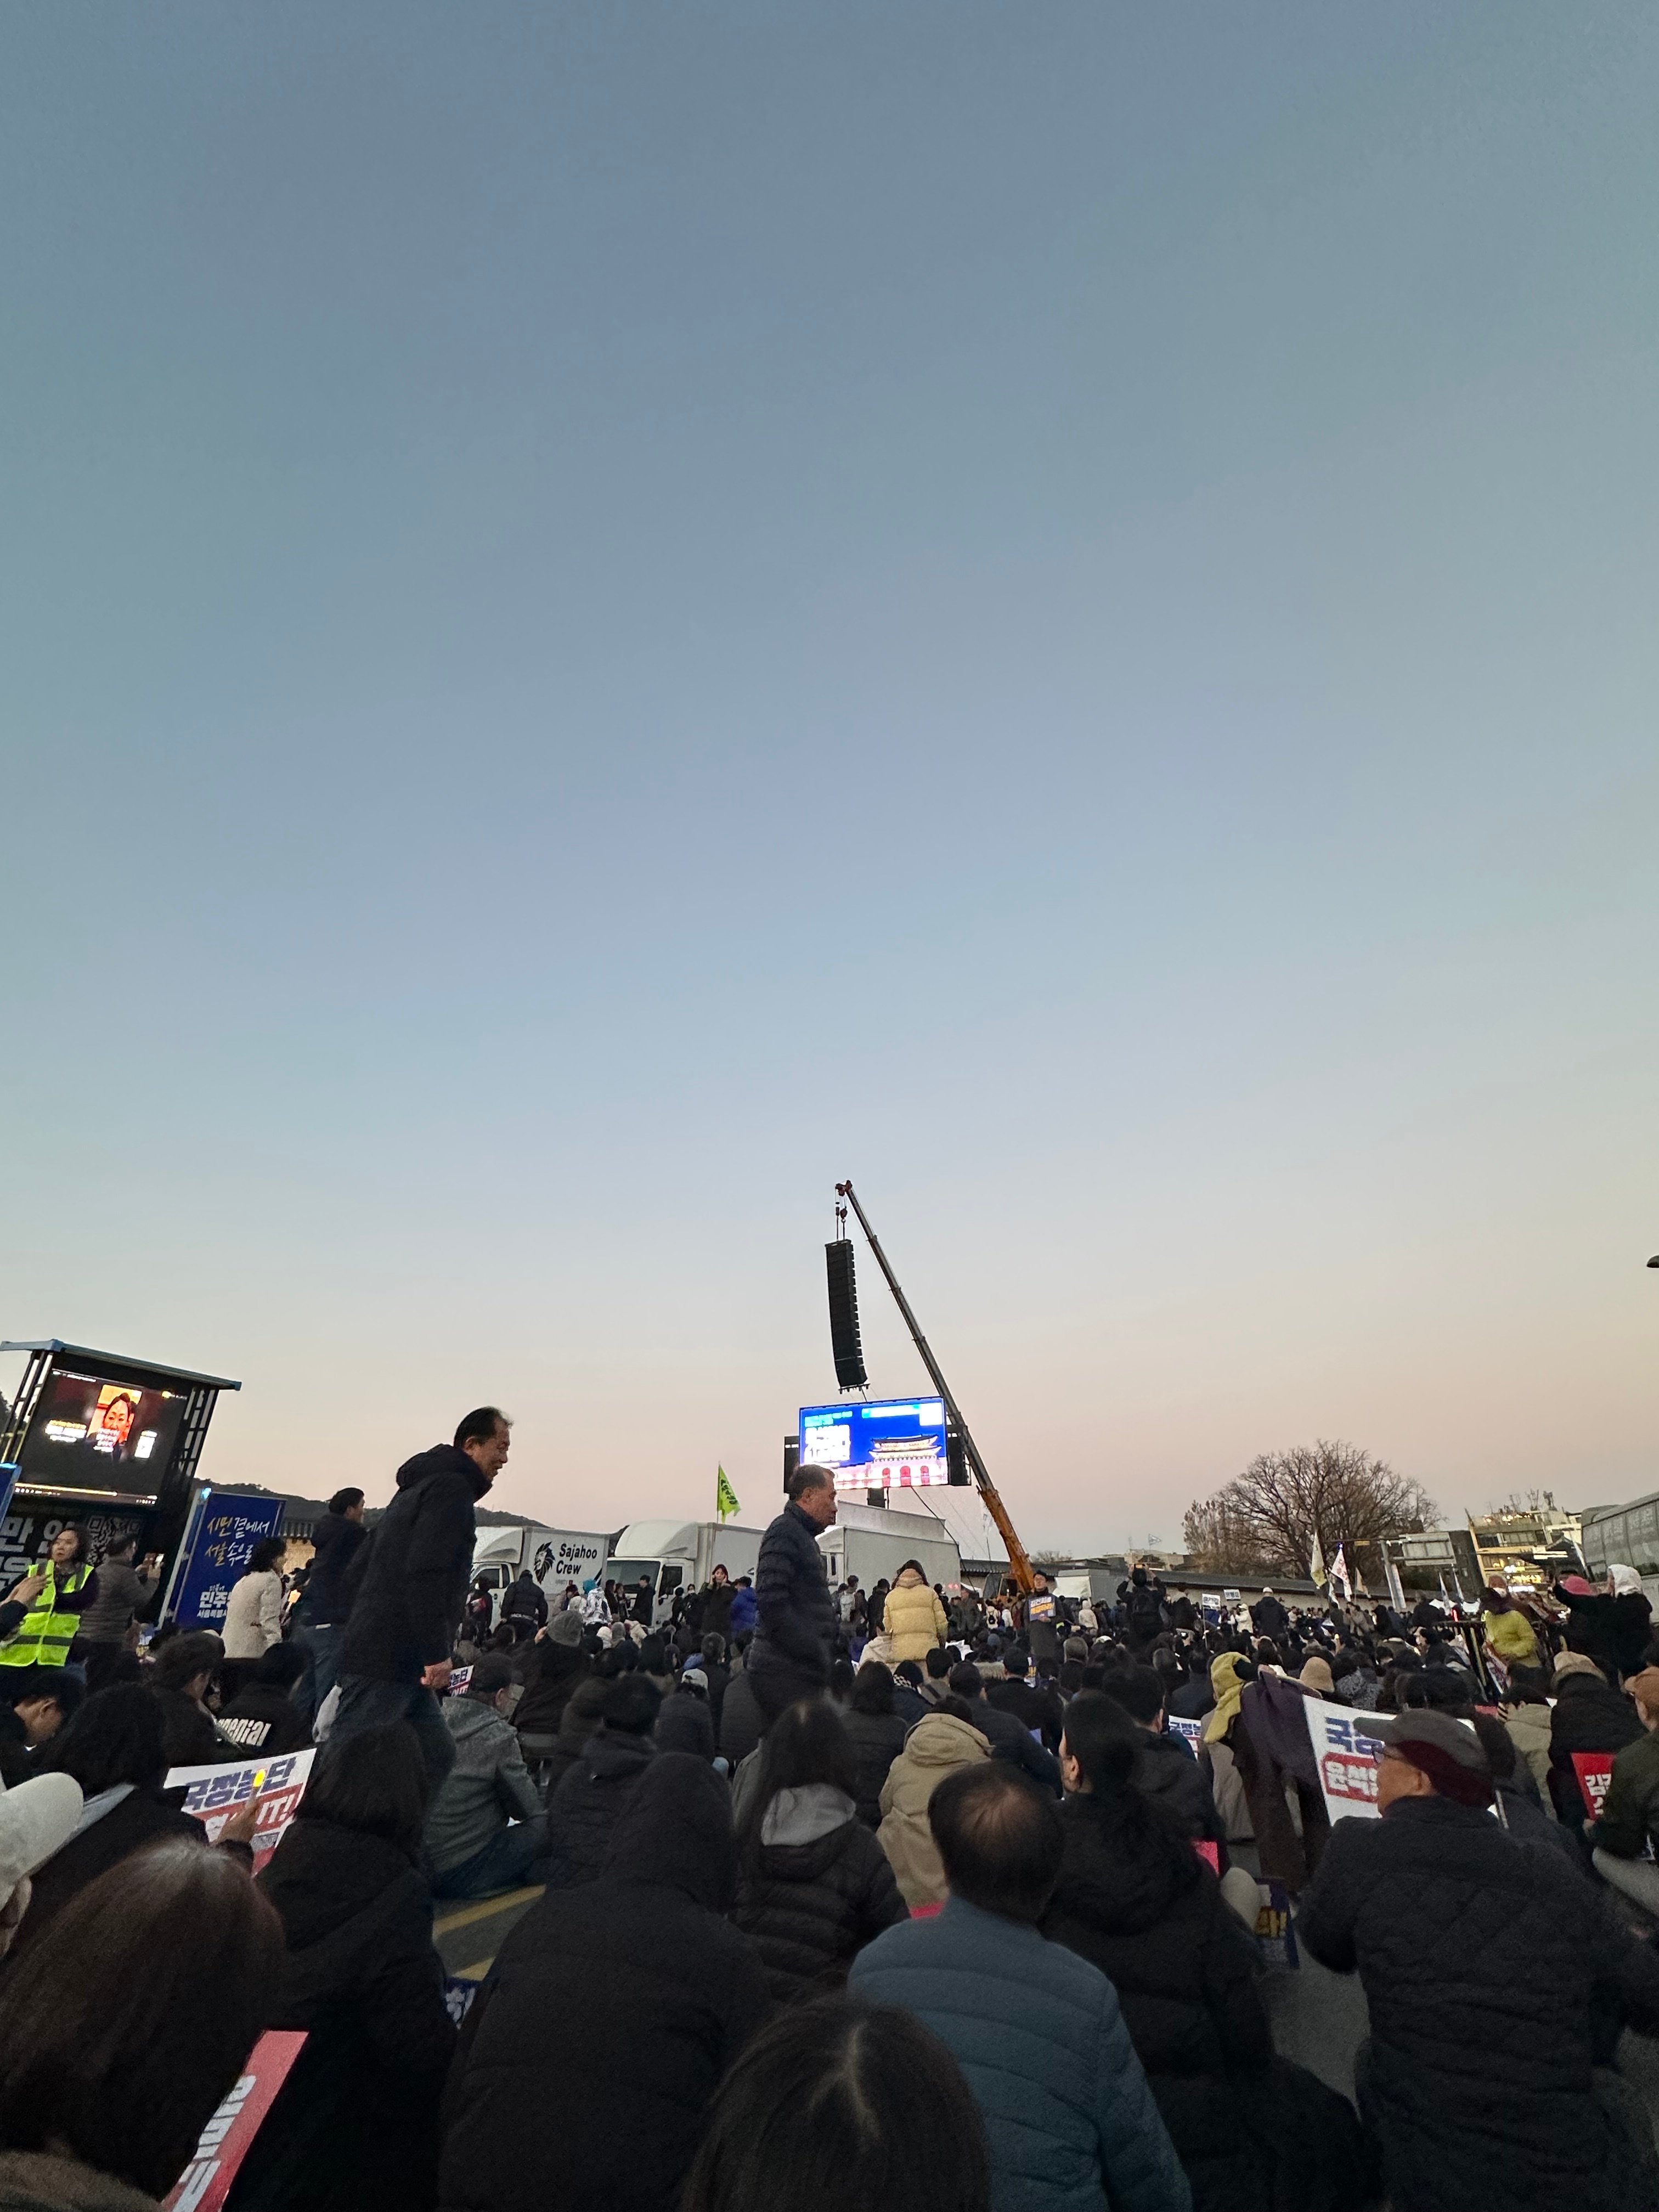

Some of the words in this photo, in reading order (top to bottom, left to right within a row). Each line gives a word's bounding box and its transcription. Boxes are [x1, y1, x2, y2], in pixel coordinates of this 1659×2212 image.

[207, 1516, 233, 1537] 시민
[234, 1517, 270, 1539] 곁에서
[205, 1541, 228, 1566] 서울
[560, 1543, 597, 1561] Sajahoo
[556, 1560, 581, 1575] Crew
[199, 1592, 230, 1607] 민주
